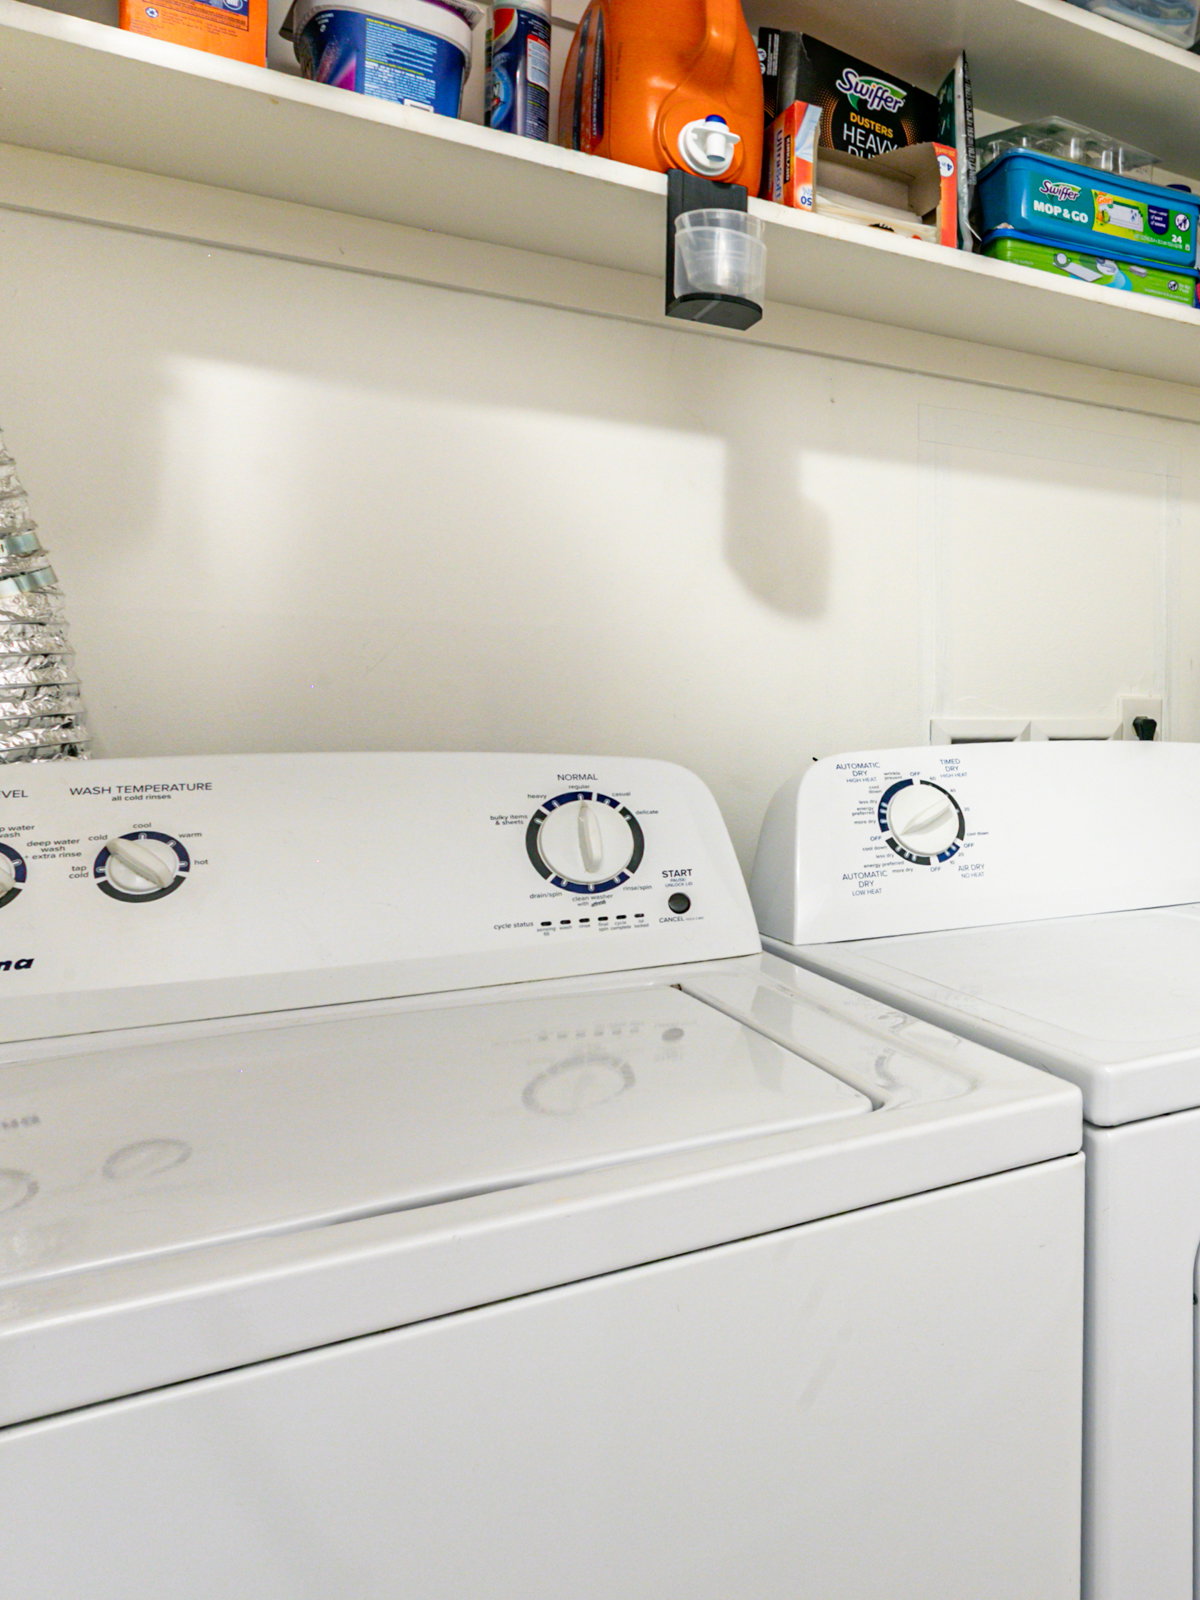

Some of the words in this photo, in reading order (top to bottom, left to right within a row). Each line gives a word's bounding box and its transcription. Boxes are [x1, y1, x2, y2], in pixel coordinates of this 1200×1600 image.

[836, 68, 905, 113] Swiffer
[849, 112, 894, 138] DUSTERS
[843, 123, 899, 155] HEAVY
[1039, 179, 1081, 202] Swiffer
[1034, 200, 1062, 216] MOP
[1071, 211, 1089, 223] GO
[1171, 234, 1183, 243] 24
[836, 762, 880, 770] AUTOMATIC
[557, 773, 599, 781] NORMAL
[69, 786, 112, 796] WASH
[116, 782, 213, 794] TEMPERATURE
[0, 789, 28, 799] VEL
[124, 793, 143, 801] cold
[490, 815, 508, 823] bulky
[88, 833, 108, 841] cold
[26, 840, 51, 848] deep
[32, 852, 56, 860] extra
[59, 850, 82, 858] rinse
[194, 858, 208, 866] hot
[71, 865, 87, 873] tap
[661, 868, 693, 878] START
[842, 870, 888, 881] AUTOMATIC
[529, 891, 563, 899] drain/spin
[493, 923, 512, 931] cycle
